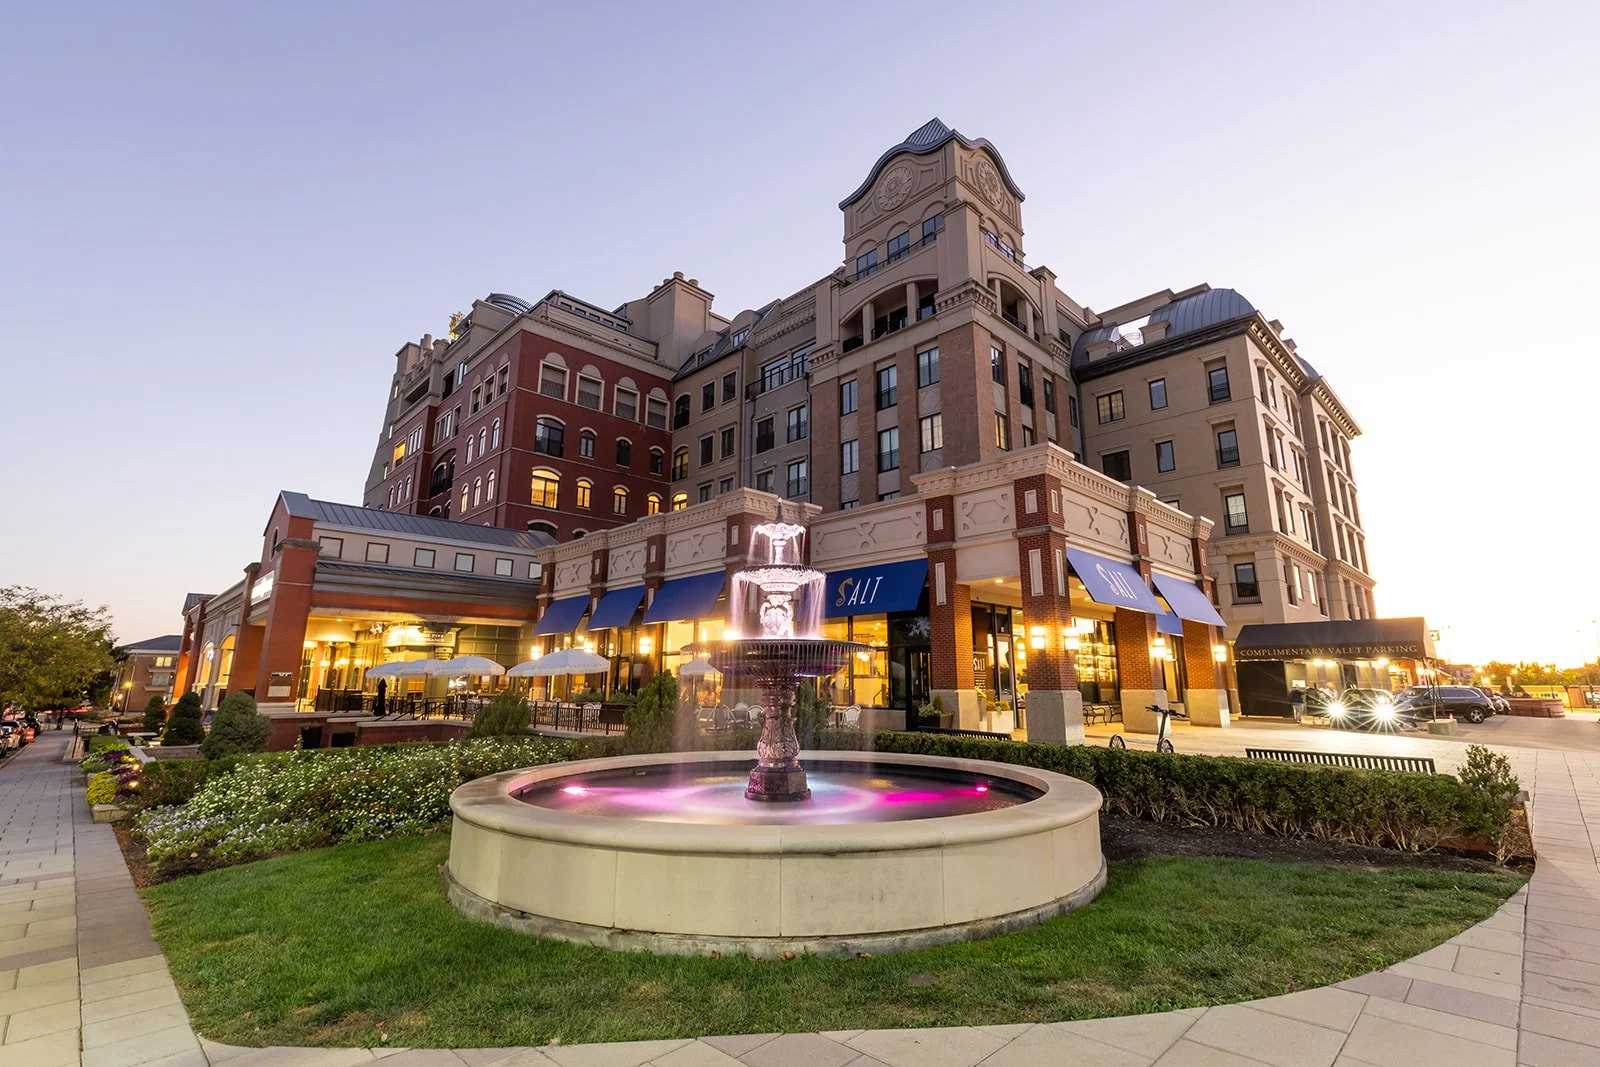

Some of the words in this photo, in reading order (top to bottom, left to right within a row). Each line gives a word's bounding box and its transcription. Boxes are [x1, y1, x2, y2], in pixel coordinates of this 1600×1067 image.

[835, 576, 883, 607] SALT
[1095, 562, 1138, 600] SALT
[1240, 648, 1324, 656] COMPLIMENTARY
[1366, 645, 1417, 653] PARKING
